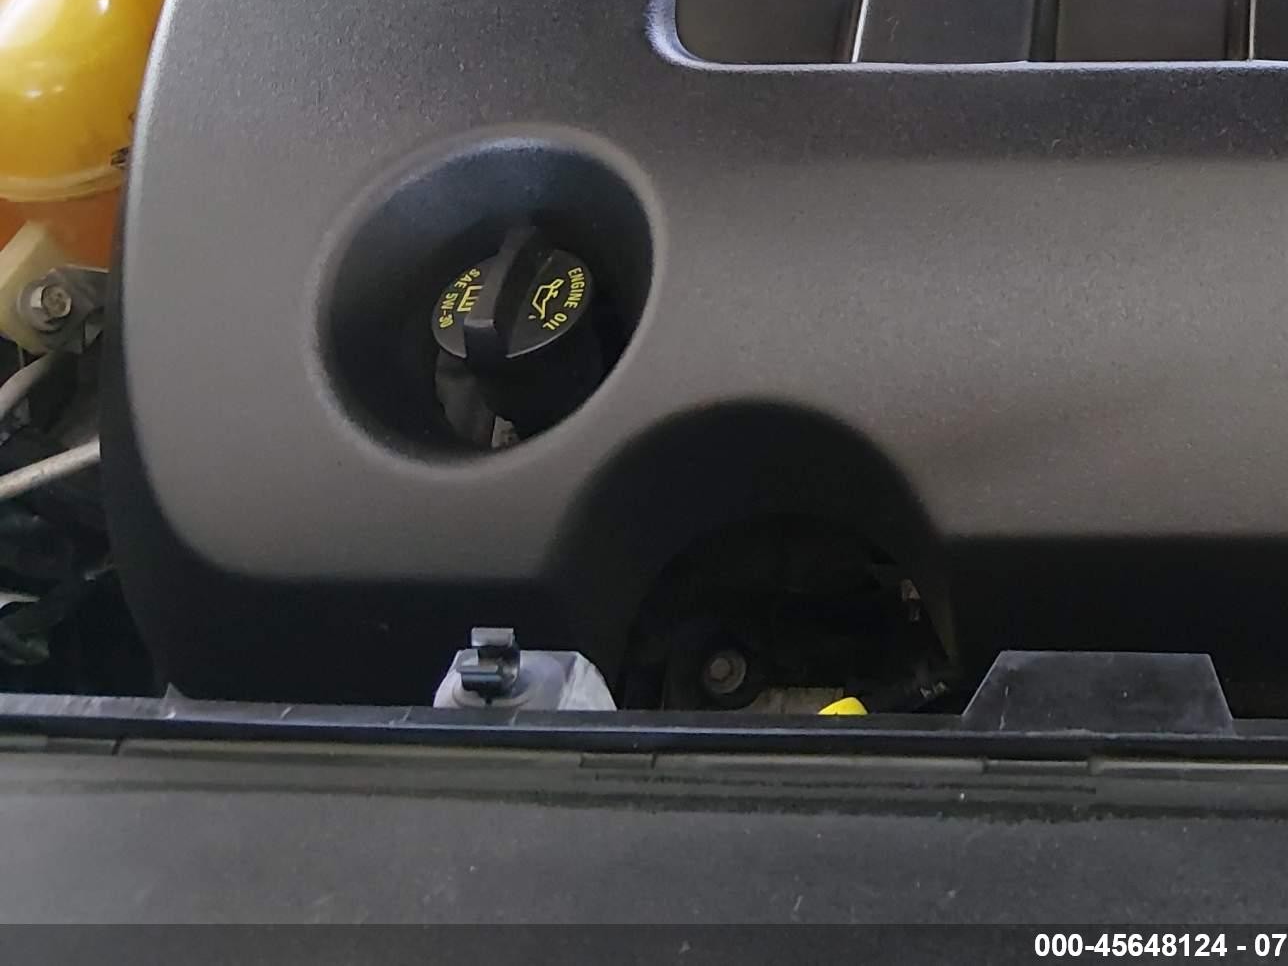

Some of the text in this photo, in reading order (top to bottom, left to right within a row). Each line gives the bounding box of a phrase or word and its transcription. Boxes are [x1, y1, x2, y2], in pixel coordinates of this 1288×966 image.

[438, 268, 481, 329] SAE 5W-30
[542, 267, 586, 331] ENGINE OIL
